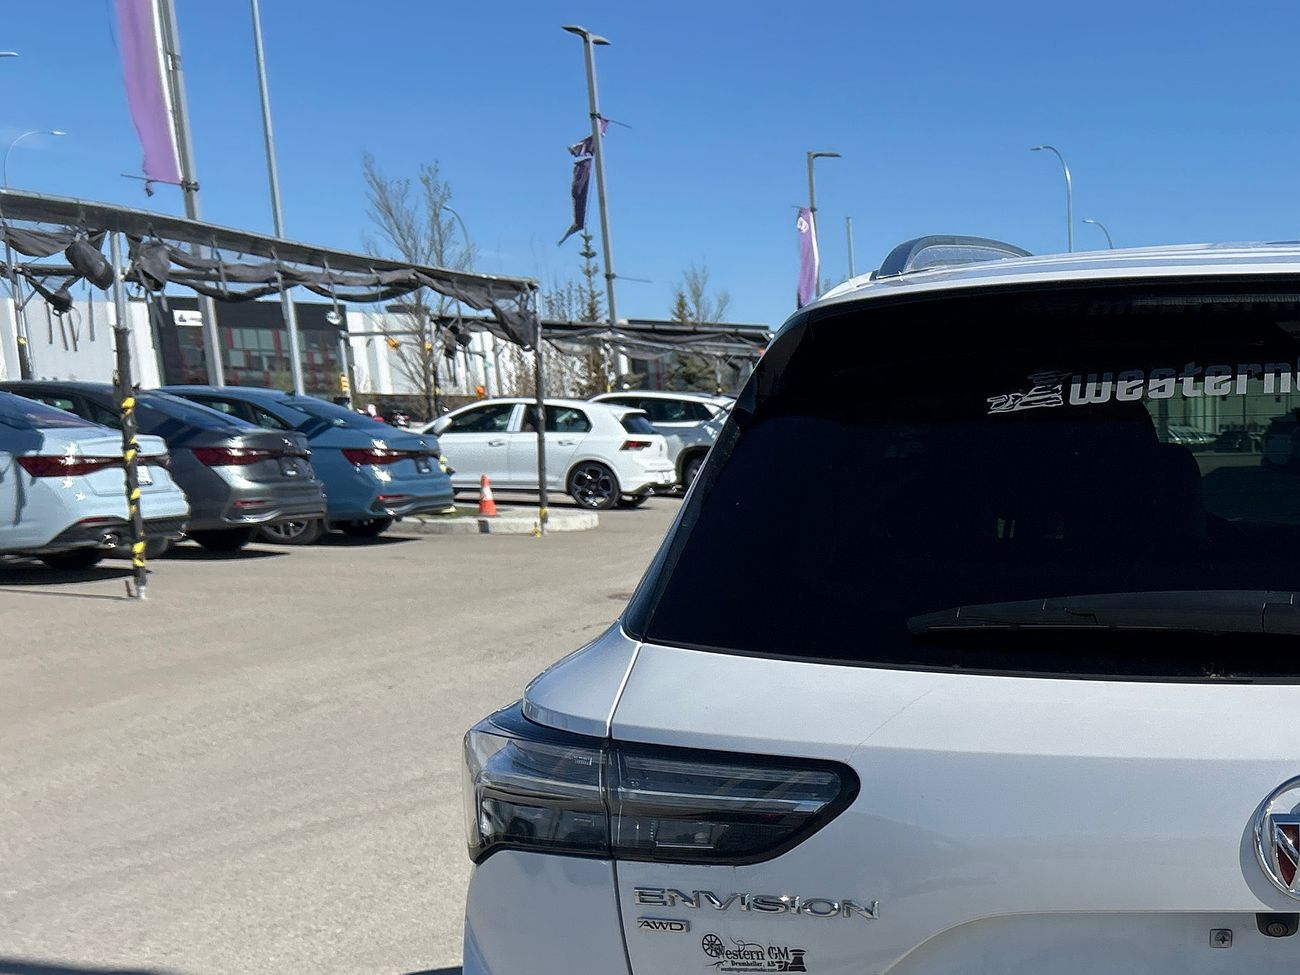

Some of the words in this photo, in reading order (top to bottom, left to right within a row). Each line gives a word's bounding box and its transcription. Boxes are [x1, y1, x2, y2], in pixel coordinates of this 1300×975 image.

[633, 886, 880, 920] ENVISION
[639, 919, 685, 931] AWD
[767, 946, 790, 960] GM
